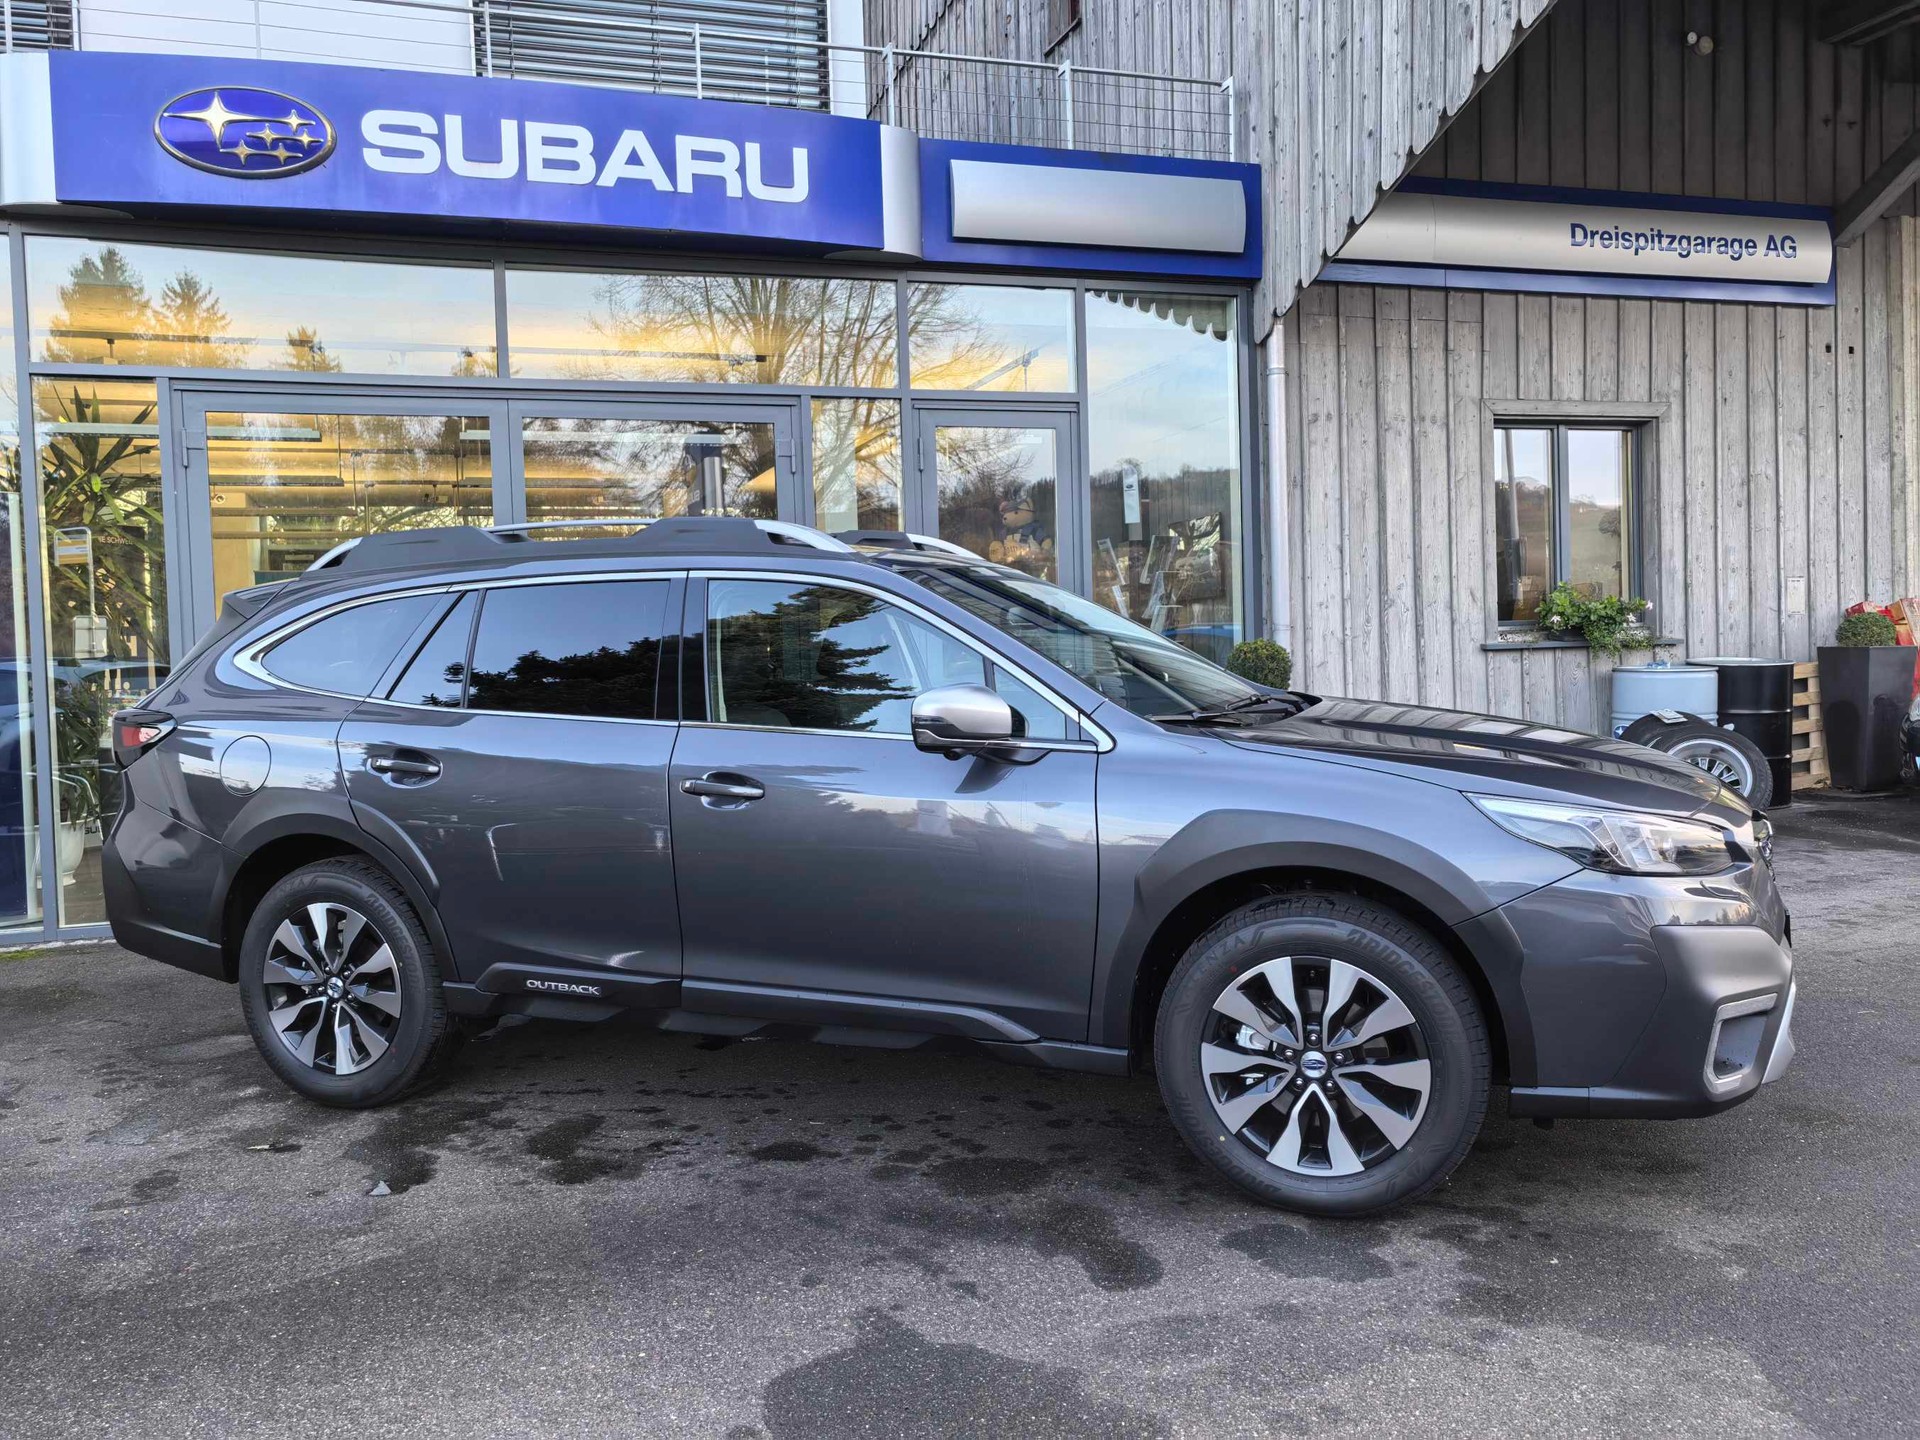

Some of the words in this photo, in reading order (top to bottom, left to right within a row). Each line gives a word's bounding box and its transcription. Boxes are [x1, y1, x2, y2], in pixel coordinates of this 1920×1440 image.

[361, 109, 809, 203] SUBARU
[1570, 222, 1758, 261] Dreispitzgarage
[1763, 234, 1797, 259] AG
[526, 979, 600, 996] OUTBACK
